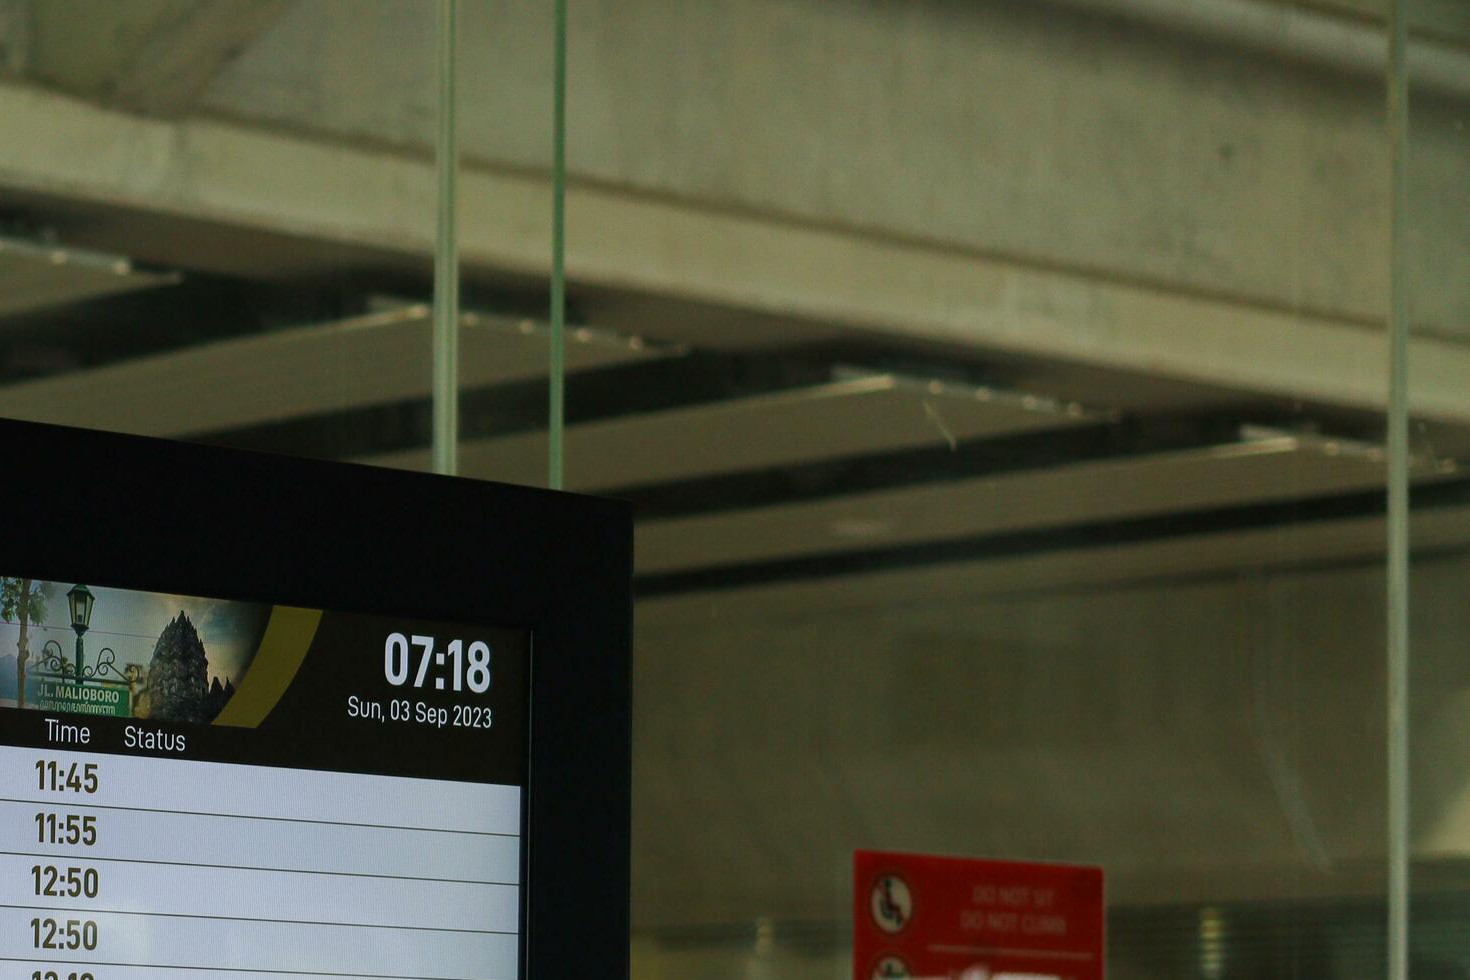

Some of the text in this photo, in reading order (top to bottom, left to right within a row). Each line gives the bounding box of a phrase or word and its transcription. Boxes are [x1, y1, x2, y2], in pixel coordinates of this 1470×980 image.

[384, 632, 491, 694] 07:18
[55, 685, 120, 704] MALIOBORO
[347, 695, 492, 729] Sun, 03 Sep 2023
[44, 718, 91, 744] Time
[124, 725, 186, 752] Status
[35, 759, 98, 794] 11:45
[34, 812, 97, 846] 11:55
[31, 865, 99, 899] 12:50
[30, 917, 98, 951] 12:50
